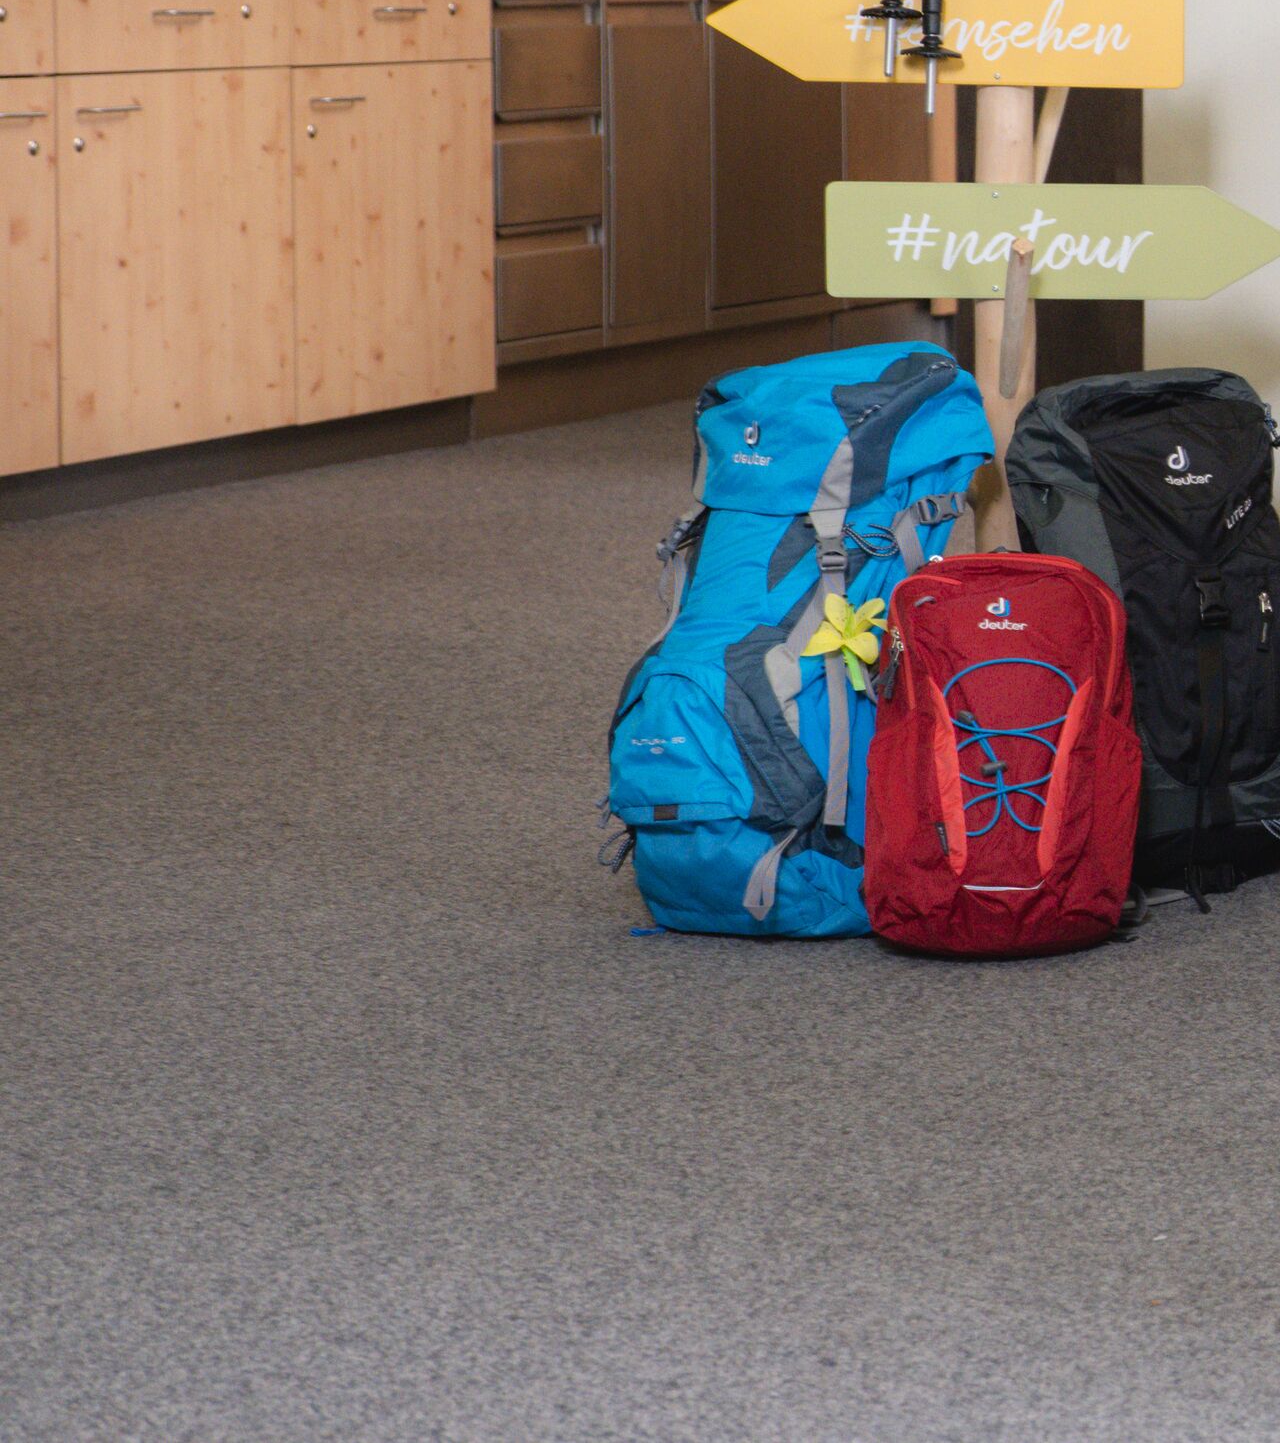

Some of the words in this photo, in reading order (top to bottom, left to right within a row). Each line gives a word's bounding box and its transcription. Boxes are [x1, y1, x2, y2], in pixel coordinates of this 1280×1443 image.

[886, 209, 1154, 275] #natour
[733, 451, 773, 467] deuter
[1164, 473, 1213, 486] deuter
[979, 619, 1028, 631] deuter
